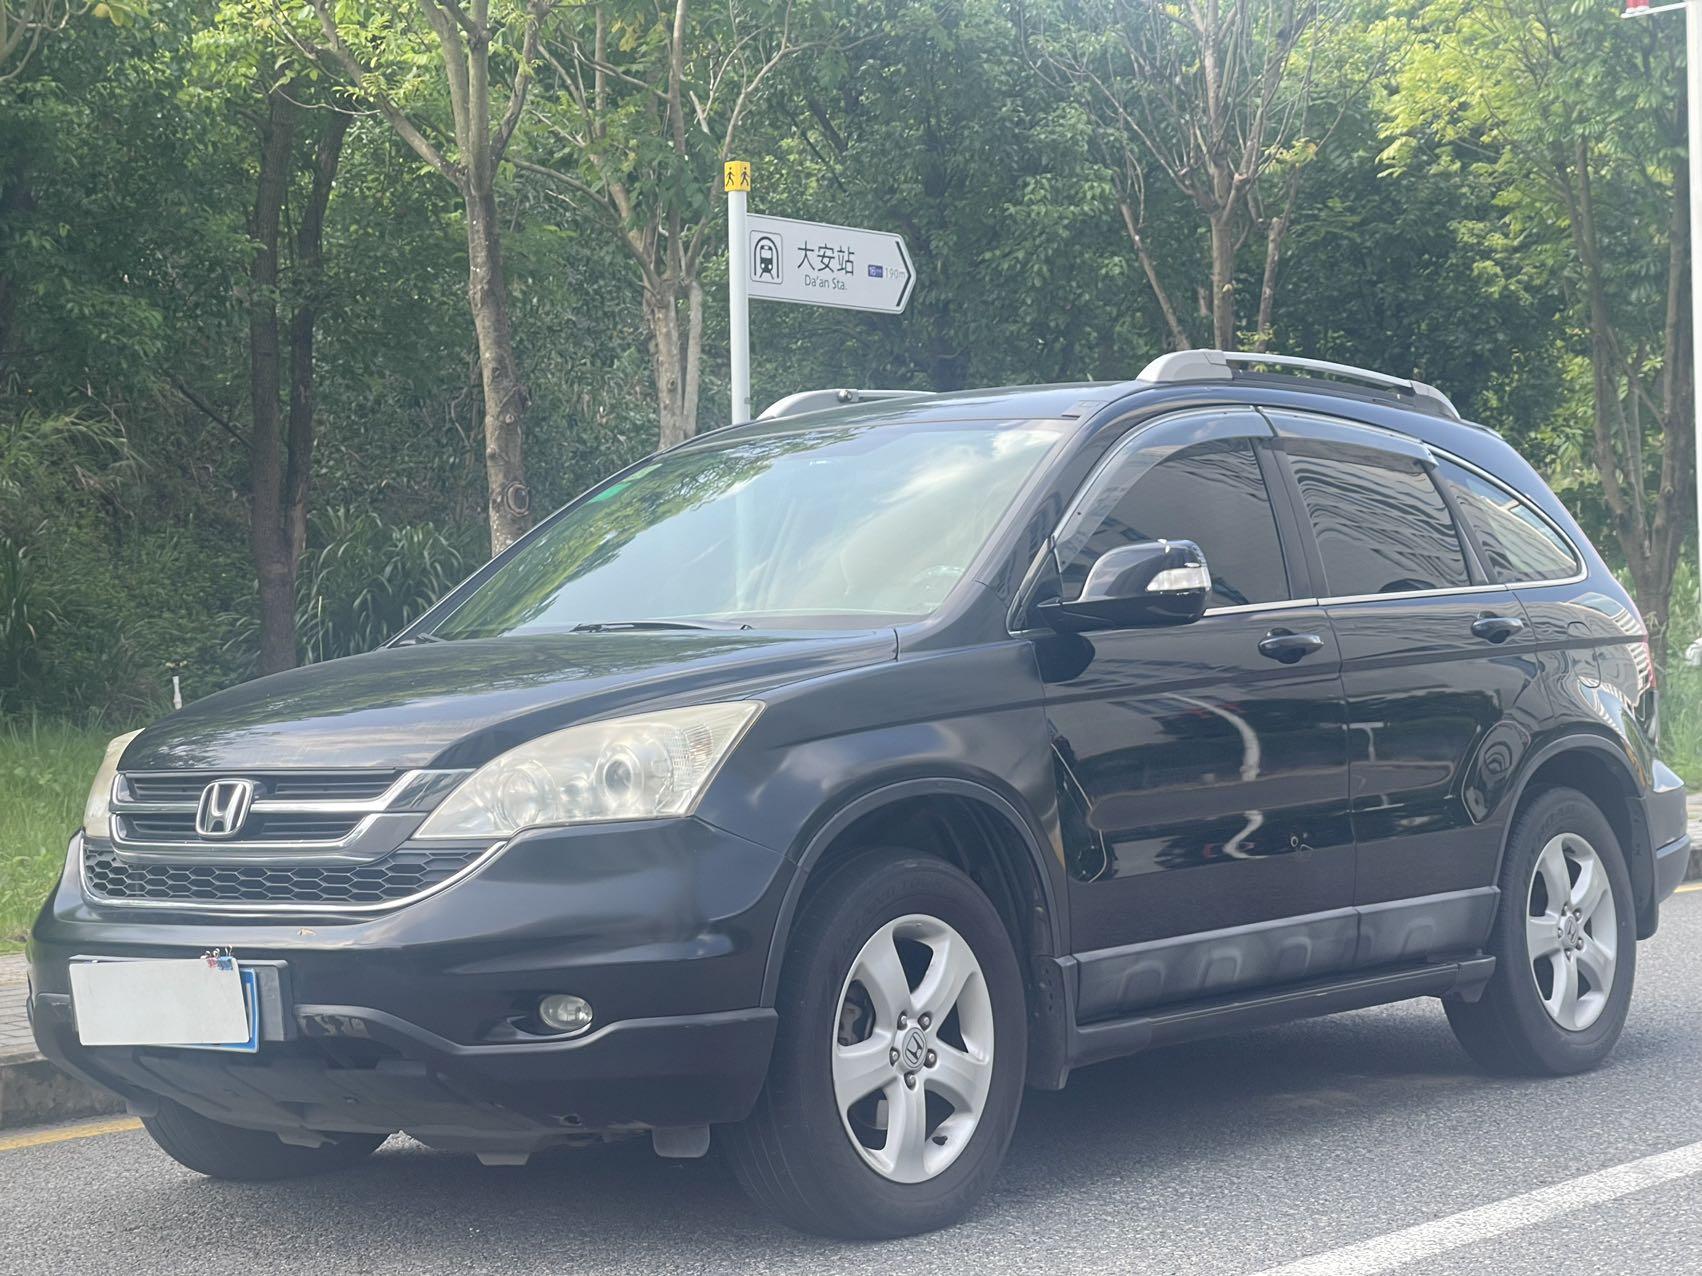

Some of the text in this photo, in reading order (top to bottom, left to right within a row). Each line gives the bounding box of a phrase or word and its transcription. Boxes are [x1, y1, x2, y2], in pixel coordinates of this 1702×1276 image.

[797, 240, 855, 276] 大安站
[804, 274, 848, 291] Da'an Sta.
